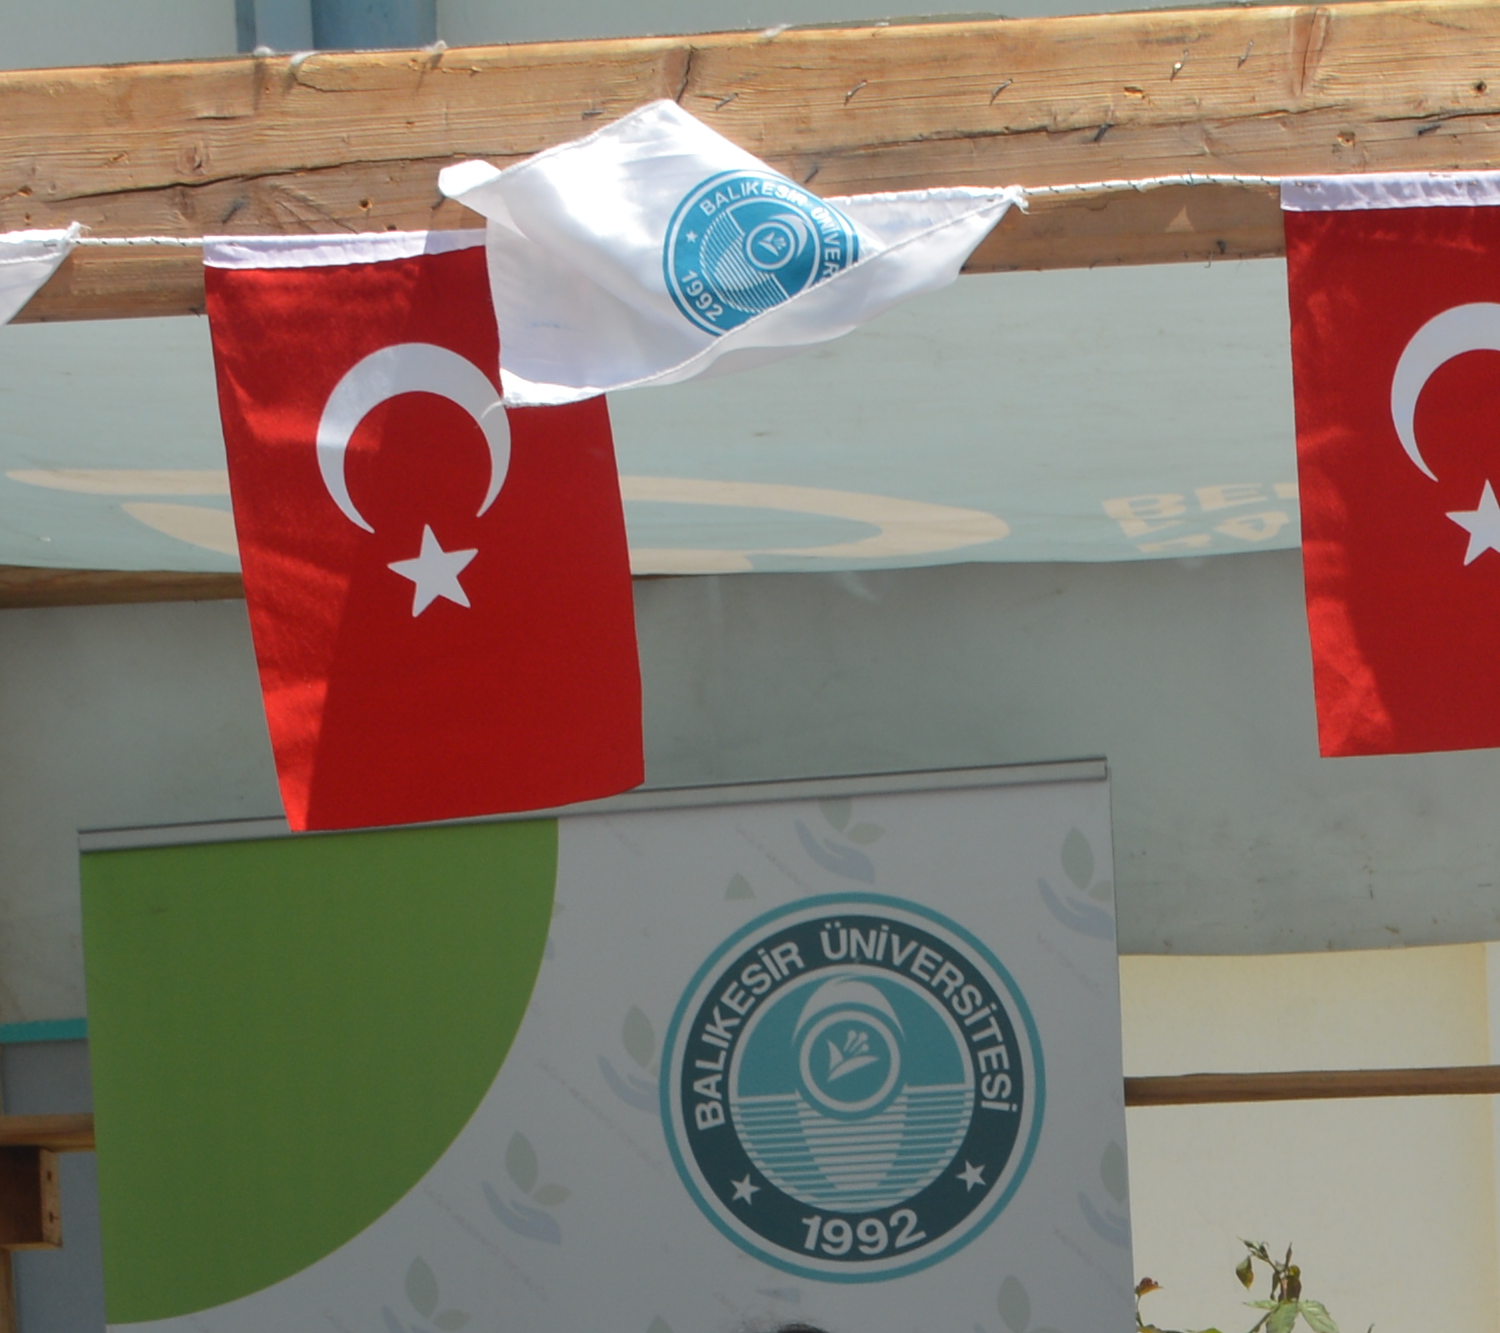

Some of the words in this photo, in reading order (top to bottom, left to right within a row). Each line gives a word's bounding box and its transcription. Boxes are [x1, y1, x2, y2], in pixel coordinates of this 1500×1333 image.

[681, 270, 724, 322] 1992
[693, 941, 805, 1131] BALIKESİR
[819, 920, 1018, 1113] ÜNİVERSİTESİ
[802, 1208, 927, 1256] 1992
